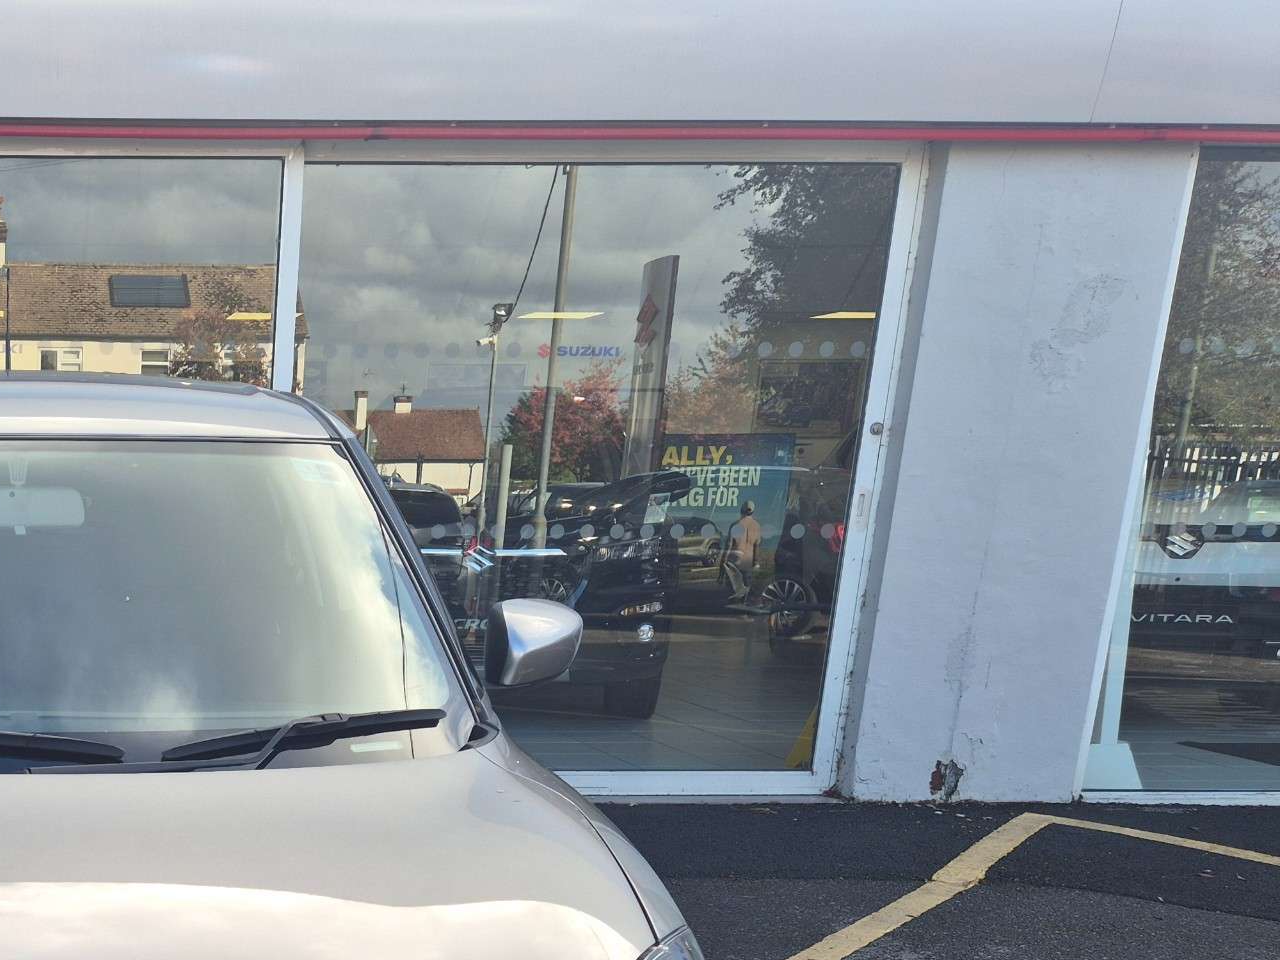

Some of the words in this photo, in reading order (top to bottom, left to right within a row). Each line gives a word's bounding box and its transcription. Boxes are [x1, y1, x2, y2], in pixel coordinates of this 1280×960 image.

[557, 345, 621, 357] SUZUKI
[718, 466, 761, 487] BEEN
[707, 487, 739, 507] FOR
[1131, 613, 1233, 624] VITARA
